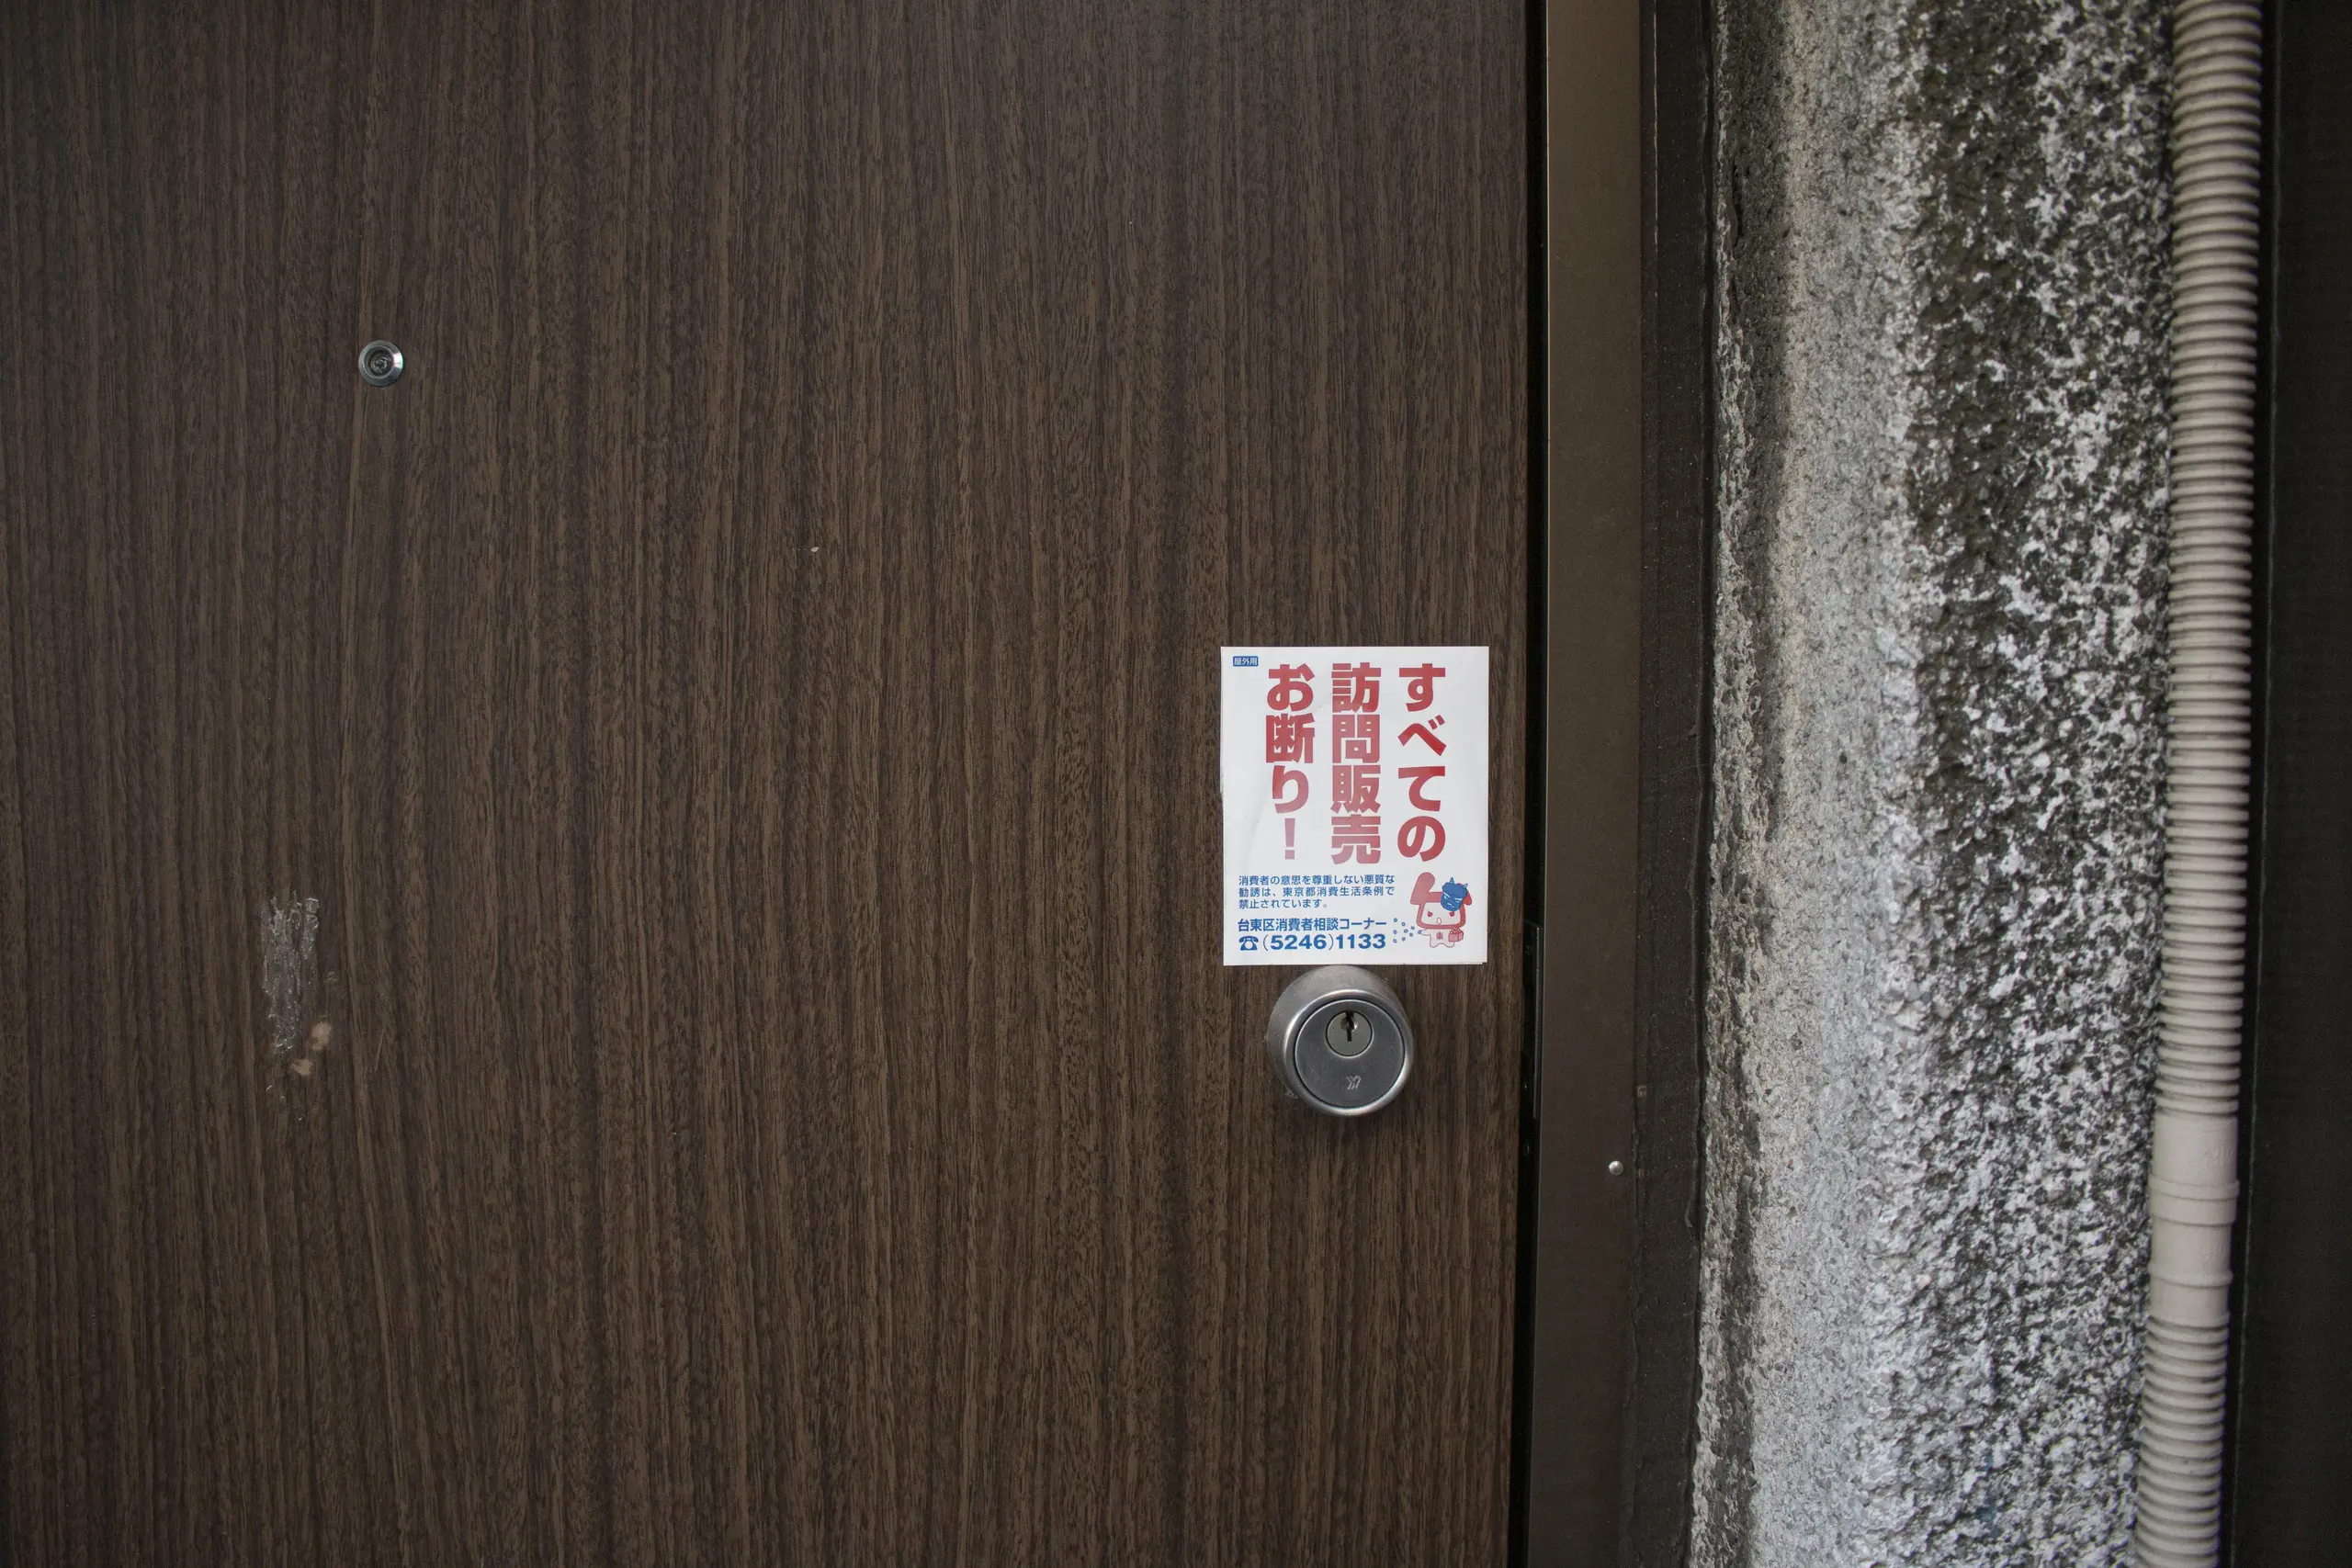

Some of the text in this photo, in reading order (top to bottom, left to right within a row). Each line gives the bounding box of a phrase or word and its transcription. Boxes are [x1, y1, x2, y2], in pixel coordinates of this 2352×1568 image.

[1234, 657, 1258, 666] 屋外用
[1265, 663, 1315, 860] お断り！
[1331, 662, 1381, 863] 訪問販売
[1397, 663, 1446, 862] すべての
[1238, 874, 1395, 886] 消費者の意思を尊重しない悪質な
[1238, 886, 1395, 898] 勧誘は、東京都消費生活条例で
[1238, 898, 1328, 909] 禁止されています。
[1238, 918, 1387, 932] 台東区消費者相談コーナー
[1262, 932, 1386, 952] (5246)1133
